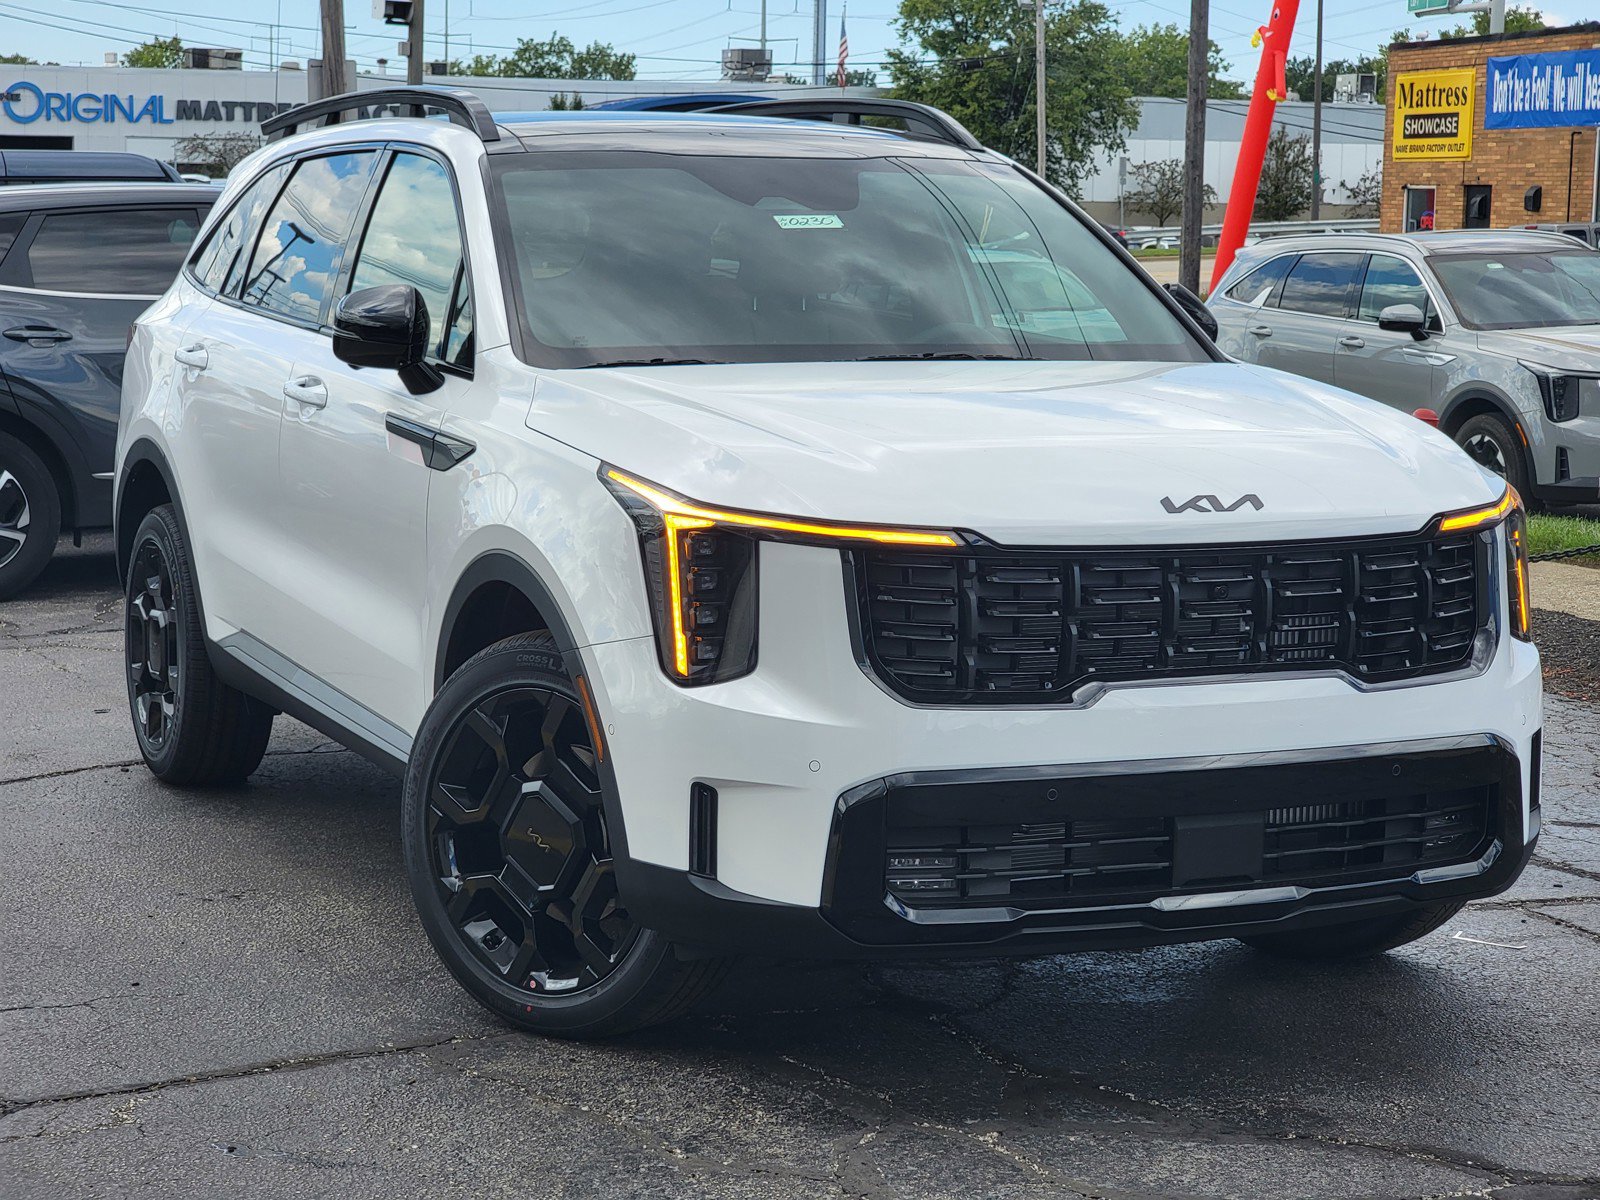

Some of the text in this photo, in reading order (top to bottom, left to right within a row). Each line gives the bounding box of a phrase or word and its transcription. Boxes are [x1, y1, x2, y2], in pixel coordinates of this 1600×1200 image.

[1398, 83, 1468, 109] Mattress
[1493, 69, 1513, 113] Don't
[1514, 68, 1523, 112] be
[1525, 78, 1530, 111] a
[1532, 66, 1551, 111] Fool!
[1554, 65, 1566, 112] We
[1568, 63, 1584, 111] will
[3, 81, 174, 124] ORIGINAL
[176, 100, 307, 122] MATTRE
[1405, 117, 1458, 135] SHOWCASE
[1395, 142, 1465, 153] NAME BRAND FACTORY OUTLET
[1160, 494, 1264, 513] KIA
[516, 654, 548, 664] CROSS
